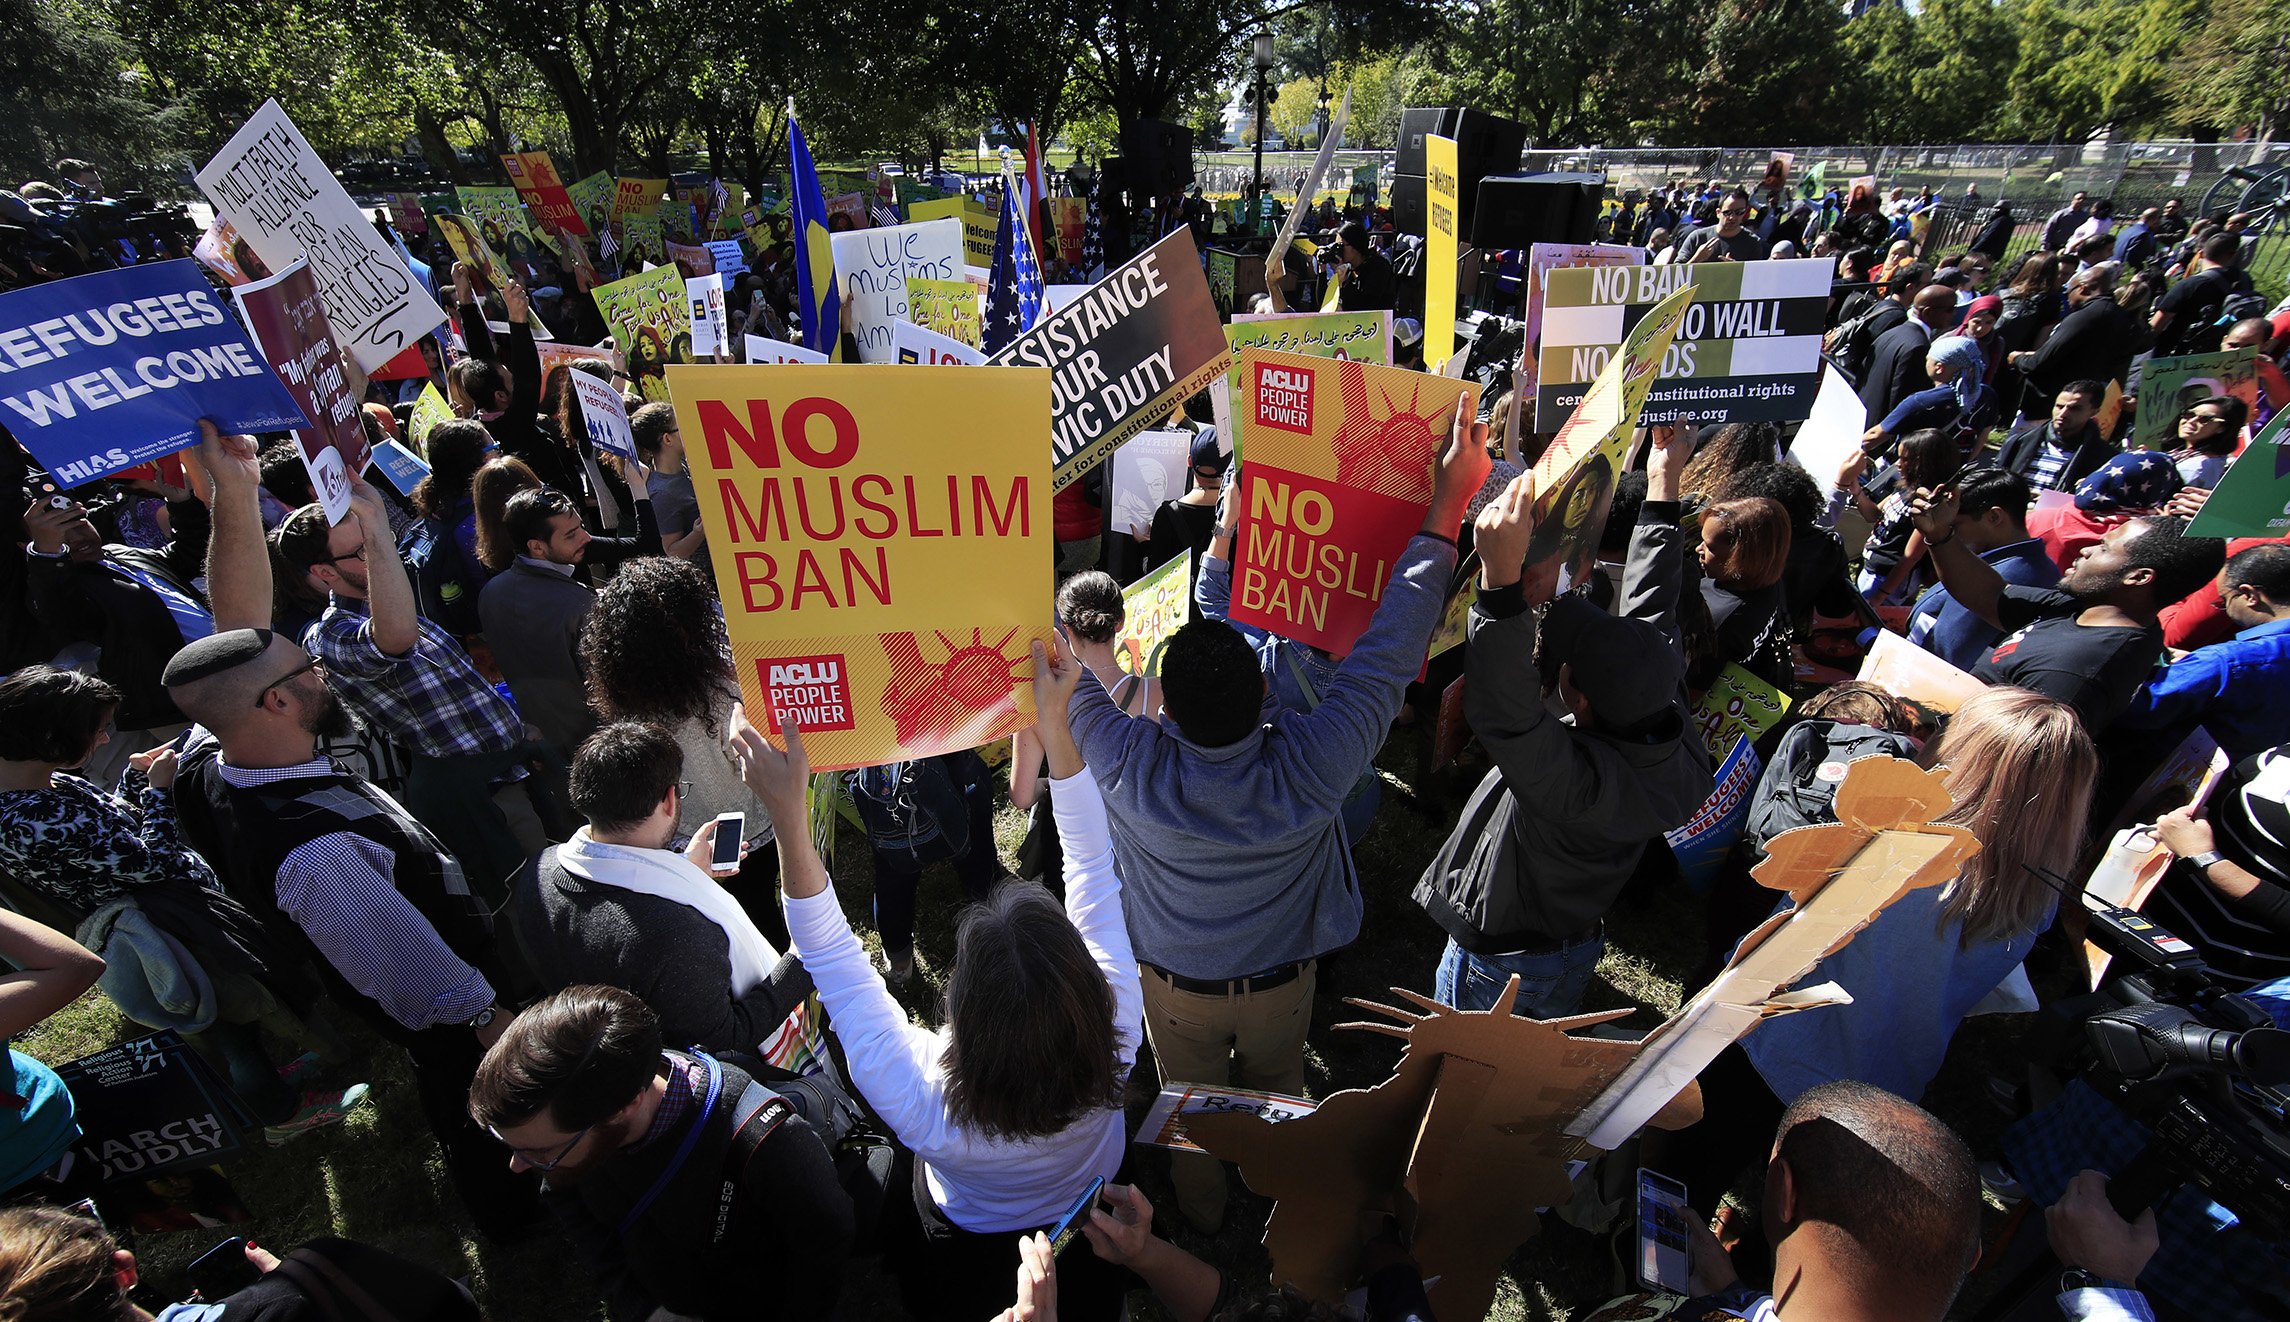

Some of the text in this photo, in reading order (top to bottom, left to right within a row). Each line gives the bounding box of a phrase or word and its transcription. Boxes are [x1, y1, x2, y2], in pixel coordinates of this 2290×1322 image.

[249, 161, 320, 239] ALLIANCE
[522, 191, 543, 205] NO
[617, 193, 661, 206] MUSLIM
[620, 182, 643, 194] NO
[528, 203, 576, 219] MUSLIM
[289, 210, 327, 252] FOR
[1591, 264, 1694, 304] NO BAN
[603, 303, 634, 324] Come
[636, 294, 655, 316] for
[886, 296, 907, 317] Lo
[911, 301, 930, 324] Come
[932, 302, 945, 325] for
[999, 252, 1169, 368] ESISTANCE
[647, 311, 662, 328] Us
[661, 303, 686, 344] All
[1713, 300, 1786, 339] WALL
[313, 337, 331, 360] was
[1570, 345, 1610, 383] NO
[1, 342, 264, 428] WELCOME
[575, 379, 587, 390] MY
[1260, 368, 1309, 393] ACLU
[310, 390, 321, 415] a
[1052, 344, 1176, 465] VIC DUTY
[1260, 387, 1308, 411] PEOPLE
[1556, 382, 1796, 407] cen onstitutional rights
[330, 388, 357, 427] refug
[1260, 404, 1308, 428] POWER
[696, 397, 860, 470] NO
[1052, 356, 1232, 494] ter for constitutional rights
[129, 443, 157, 455] Welcome
[168, 430, 195, 442] stranger.
[133, 449, 156, 460] Protect
[167, 437, 192, 450] refugee.
[55, 448, 130, 483] HIAS
[389, 456, 411, 471] REFU
[395, 463, 420, 478] WELC
[717, 473, 1031, 544] MUSLIM
[1250, 476, 1334, 537] NO
[1247, 523, 1385, 603] MUSLI
[733, 545, 893, 613] BAN
[1241, 567, 1329, 633] BAN
[769, 661, 839, 687] ACLU
[770, 685, 842, 706] PEOPLE
[774, 705, 846, 726] POWER
[1687, 771, 1754, 837] WELCOME
[1683, 836, 1706, 850] WHEN
[1706, 827, 1720, 840] SHE
[78, 1048, 124, 1067] Religious
[85, 1060, 132, 1075] Religious
[98, 1072, 131, 1084] Center
[101, 1065, 133, 1078] Action
[84, 1113, 221, 1162] ARCH
[103, 1129, 222, 1179] UDLY
[714, 1180, 734, 1243] EOS DIGITAL
